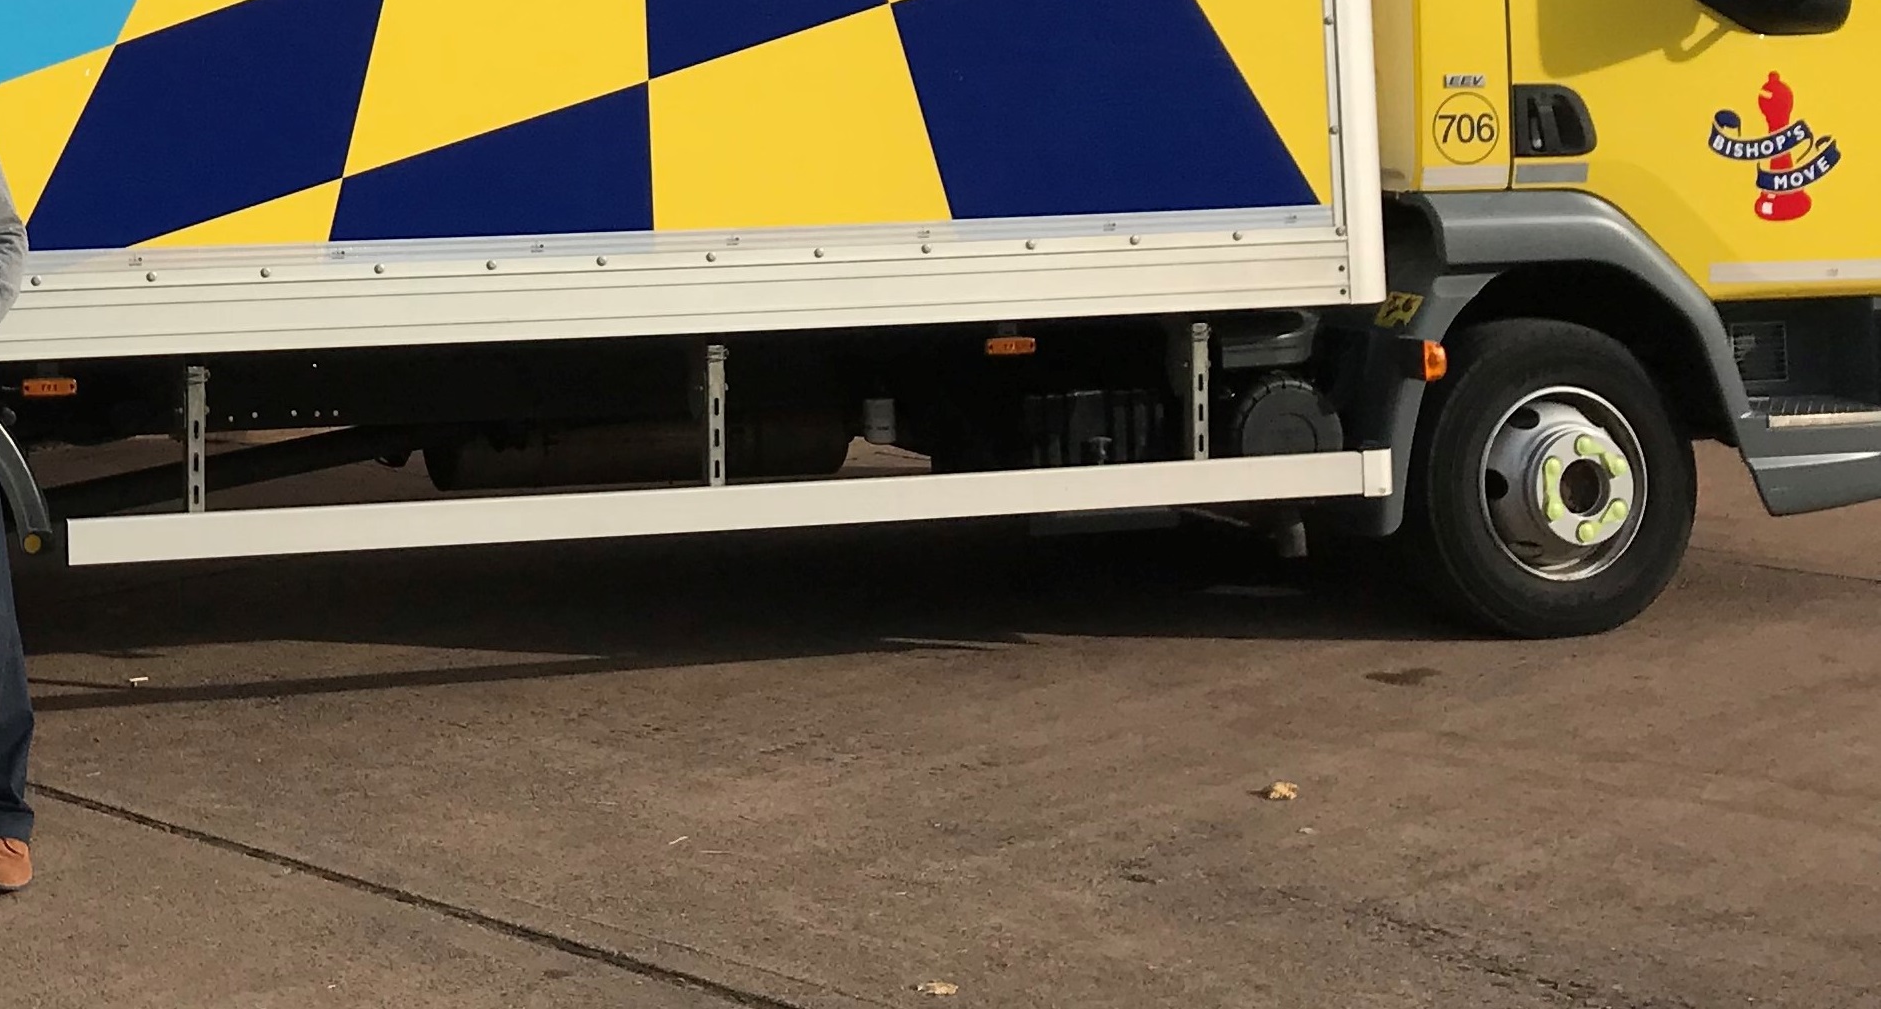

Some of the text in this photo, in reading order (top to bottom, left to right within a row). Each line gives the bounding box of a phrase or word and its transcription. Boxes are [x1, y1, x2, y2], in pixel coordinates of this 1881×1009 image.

[1438, 113, 1495, 144] 706
[1712, 124, 1806, 158] BISHOP'S
[1773, 155, 1830, 190] MOVE
